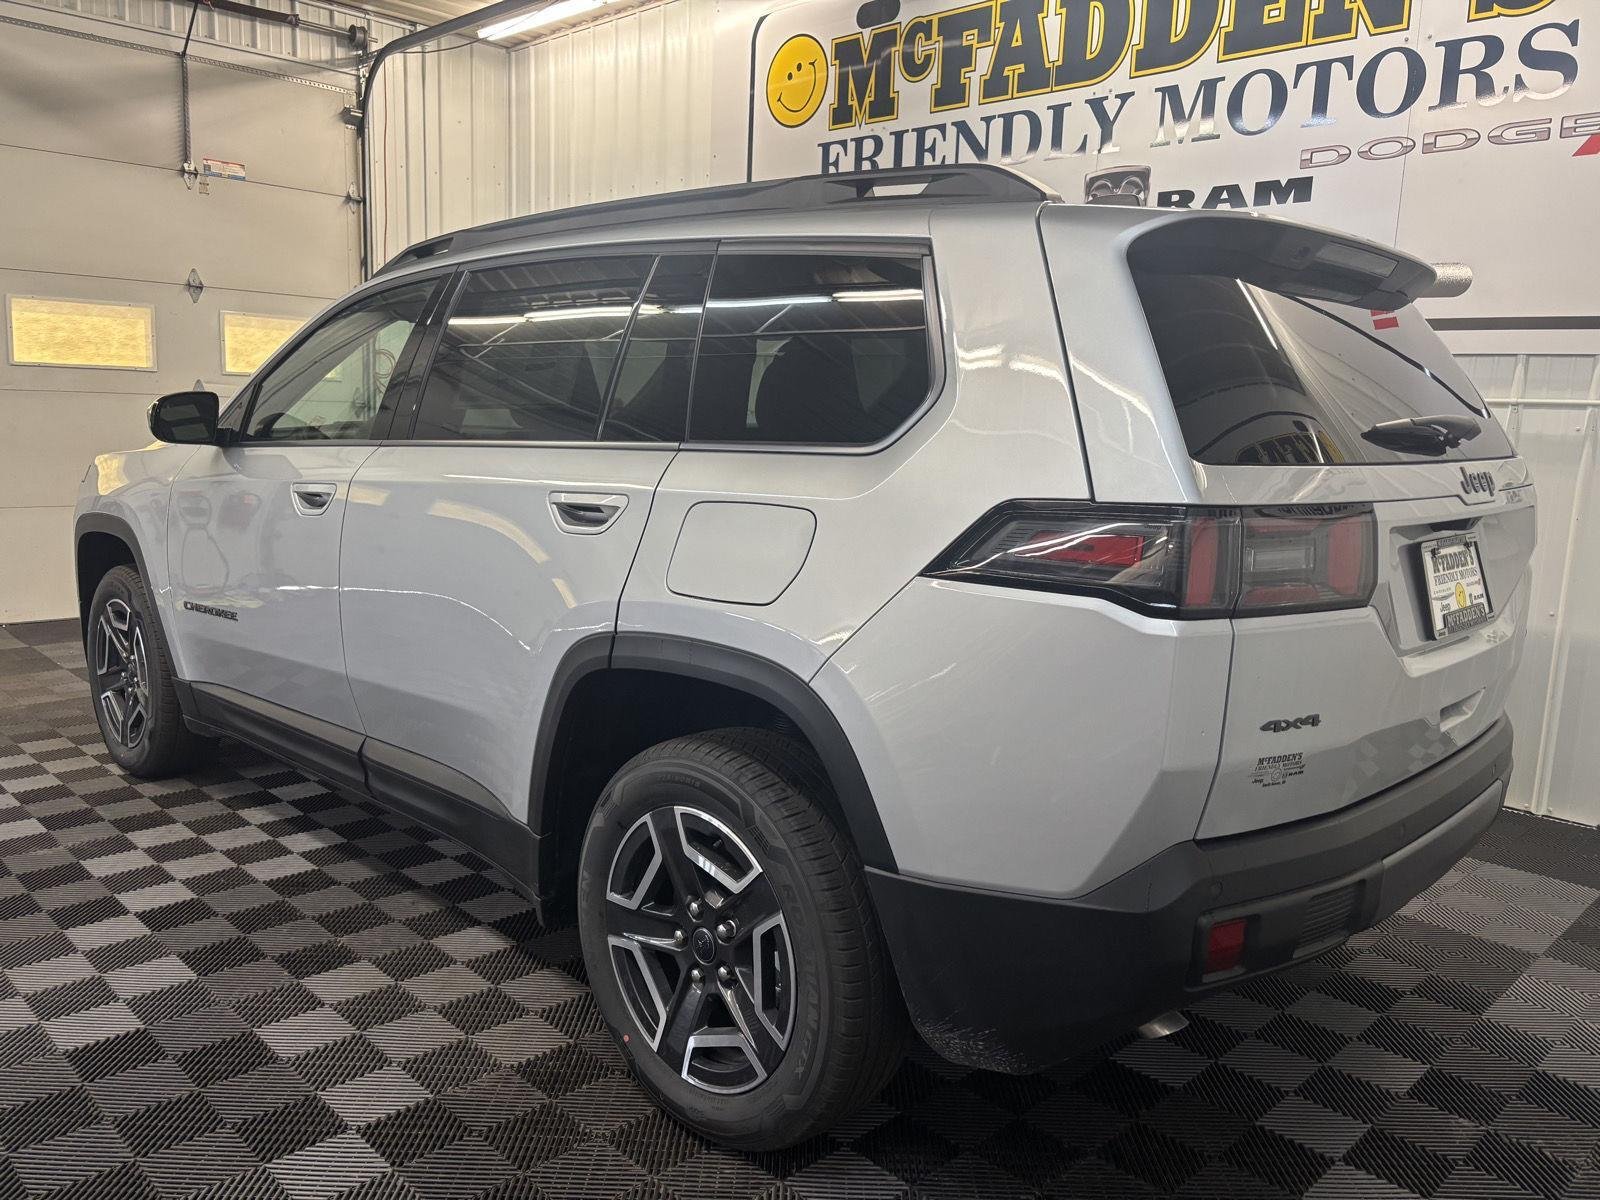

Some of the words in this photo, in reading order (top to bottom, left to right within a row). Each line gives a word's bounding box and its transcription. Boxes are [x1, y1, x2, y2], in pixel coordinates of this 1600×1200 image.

[828, 0, 1553, 131] McFADDE
[817, 91, 1136, 175] FRIENDLY
[1150, 19, 1580, 148] MOTORS
[1300, 112, 1600, 169] DODGE
[1156, 176, 1314, 209] RAM
[1459, 466, 1495, 497] Jeep
[183, 601, 239, 621] CHEROKEE
